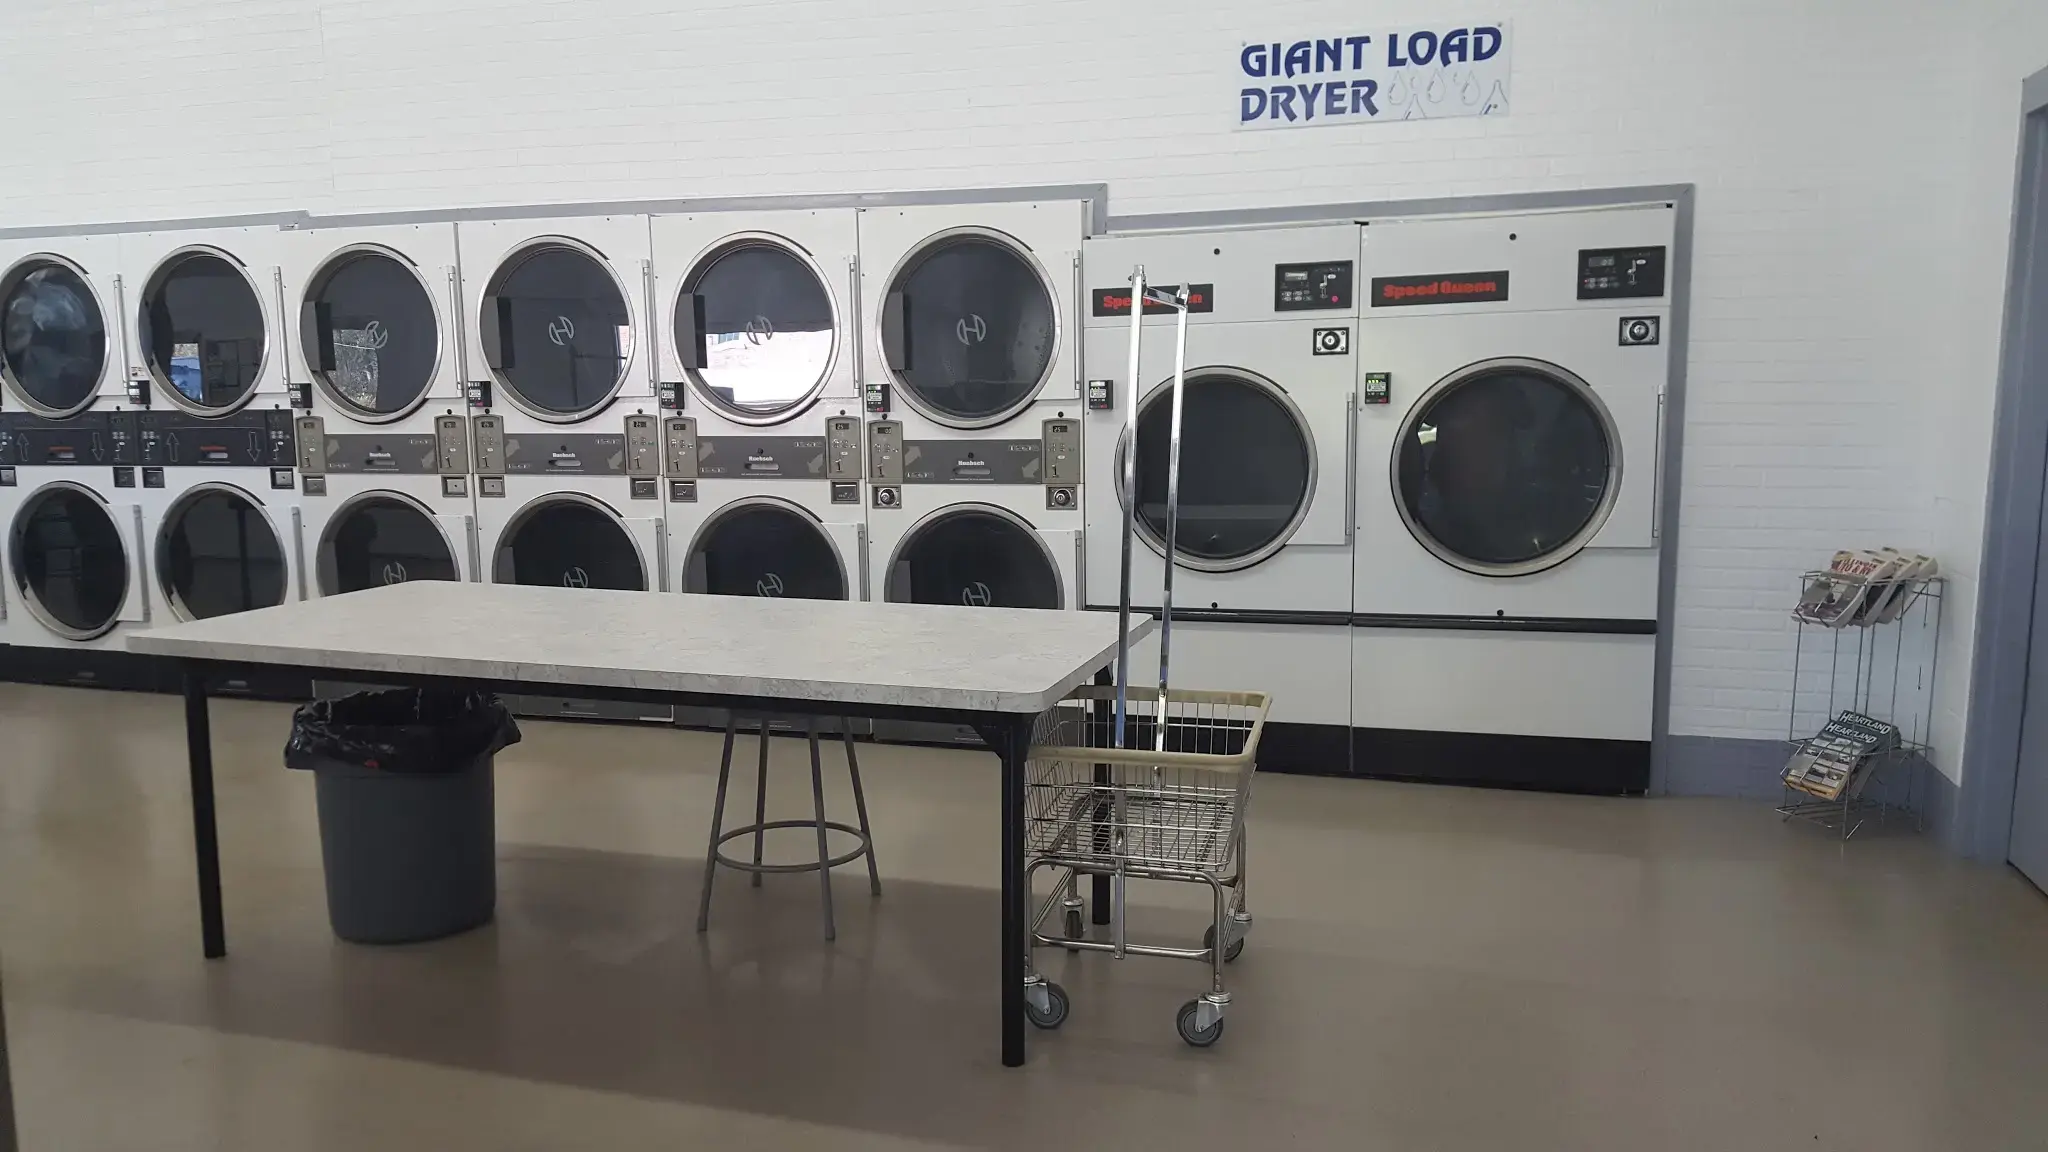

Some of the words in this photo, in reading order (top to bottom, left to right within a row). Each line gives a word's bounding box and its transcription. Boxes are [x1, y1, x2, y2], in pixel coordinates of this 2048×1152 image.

[1240, 36, 1371, 79] GIANT
[1387, 26, 1503, 68] LOAD
[1240, 79, 1380, 122] DRYER
[1825, 722, 1877, 744] HEARTLAND
[1840, 712, 1891, 734] HEARTLAND
